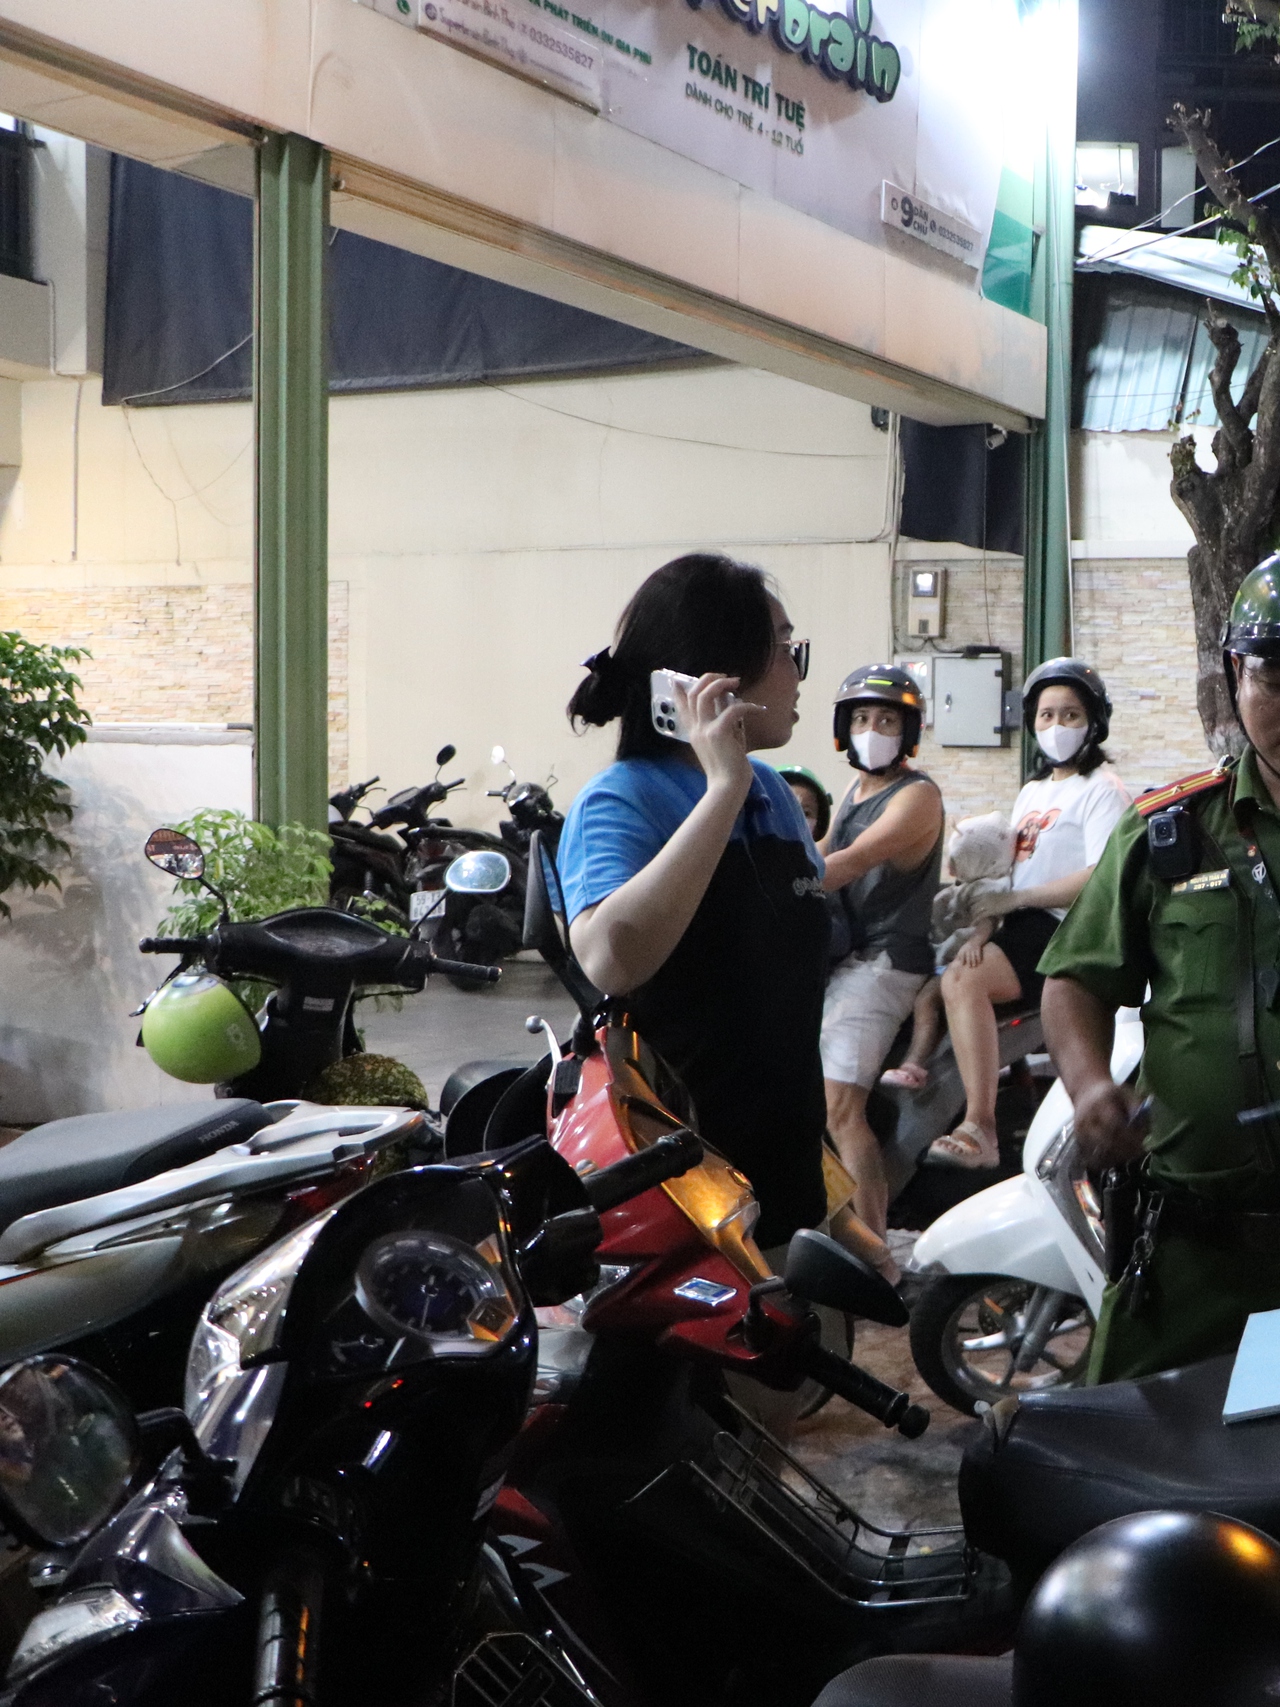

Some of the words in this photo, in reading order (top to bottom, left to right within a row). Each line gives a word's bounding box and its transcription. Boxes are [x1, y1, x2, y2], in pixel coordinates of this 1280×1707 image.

[529, 27, 595, 70] 0332535827
[685, 81, 712, 108] DÀNH
[714, 98, 734, 120] CHO
[757, 121, 763, 135] 4
[686, 42, 738, 93] TOÁN
[742, 74, 771, 110] TRÍ
[775, 91, 806, 132] TUỆ
[901, 196, 914, 228] 9
[198, 1120, 240, 1143] HONDA
